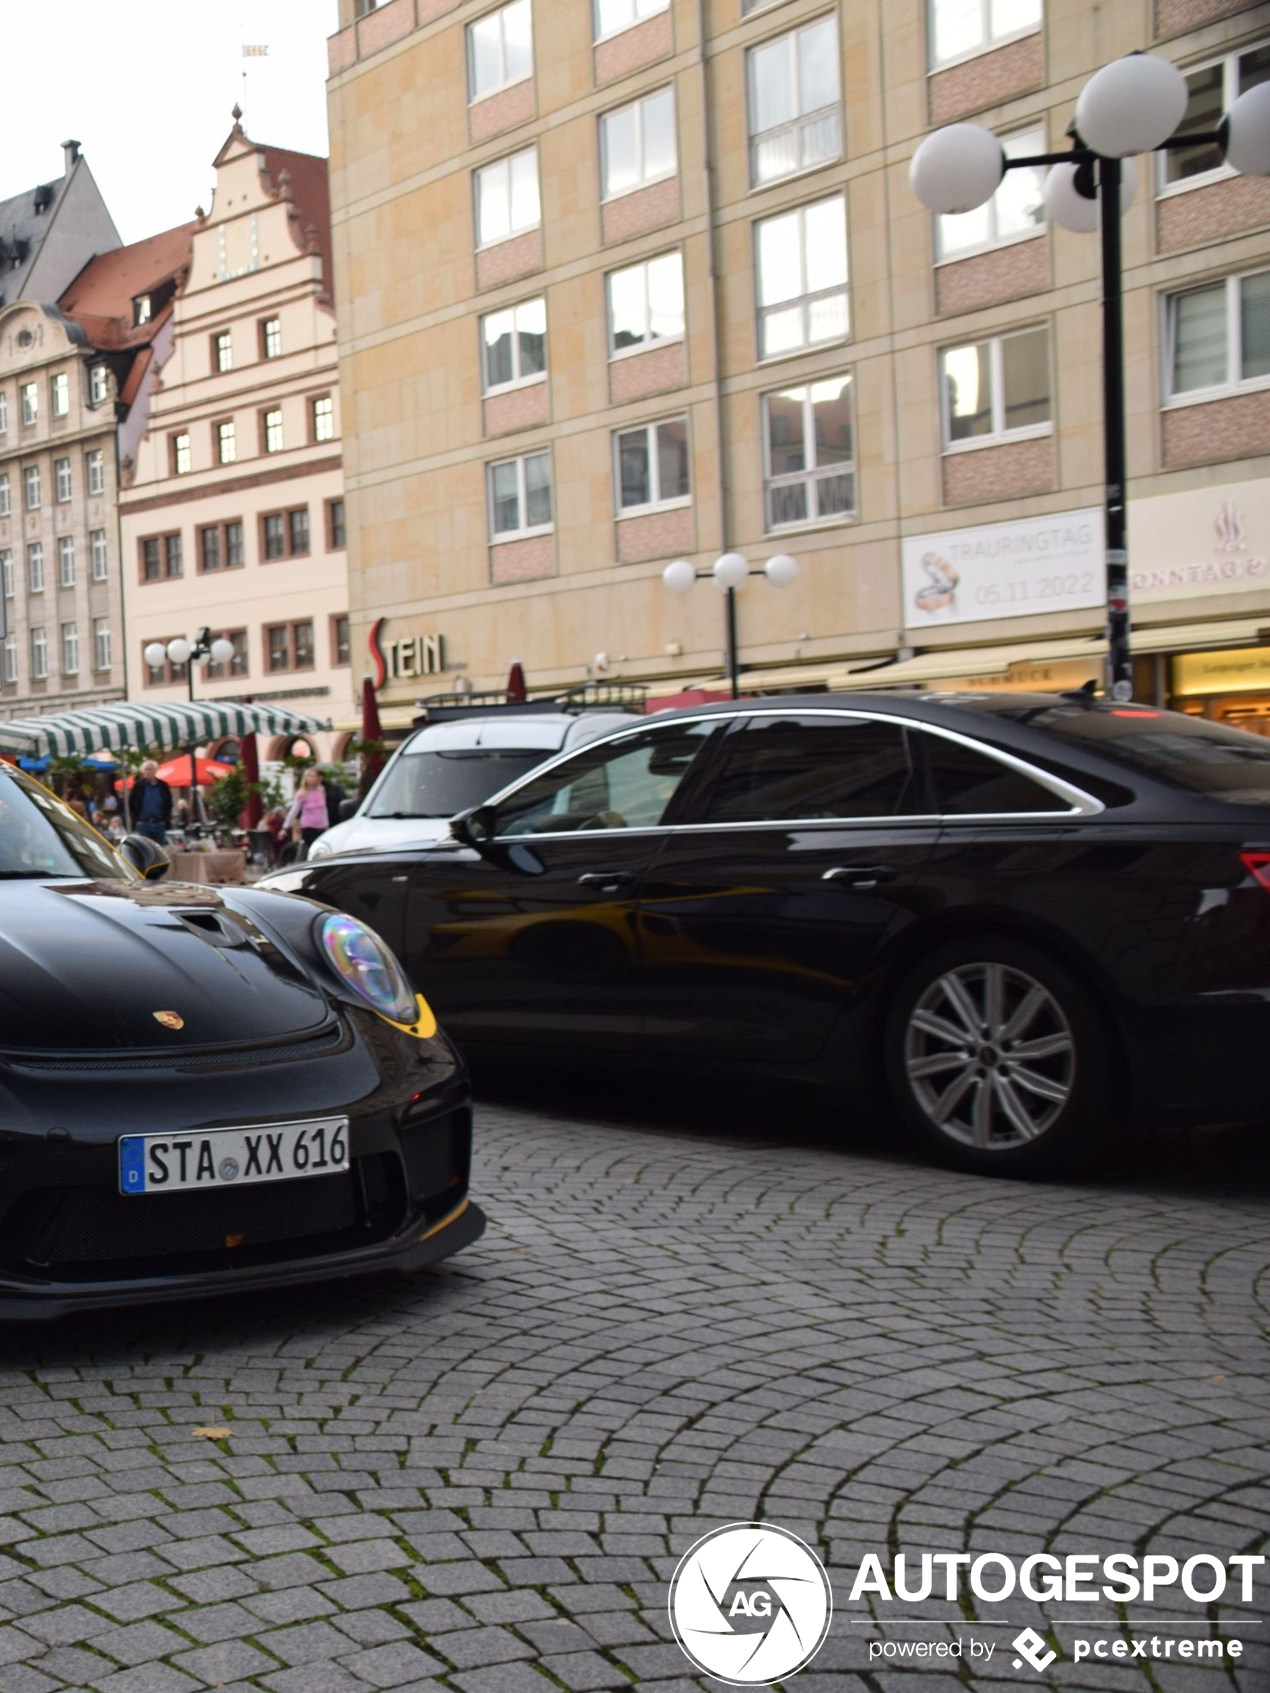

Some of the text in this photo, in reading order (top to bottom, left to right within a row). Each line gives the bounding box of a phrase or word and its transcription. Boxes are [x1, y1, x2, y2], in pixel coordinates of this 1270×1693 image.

[949, 524, 1092, 561] TRAURINGTAG
[974, 572, 1095, 605] 05.11.2022
[1132, 559, 1242, 590] ONNTAG
[367, 617, 444, 692] STEIN
[148, 1125, 346, 1185] STA XX 616
[129, 1170, 139, 1183] D
